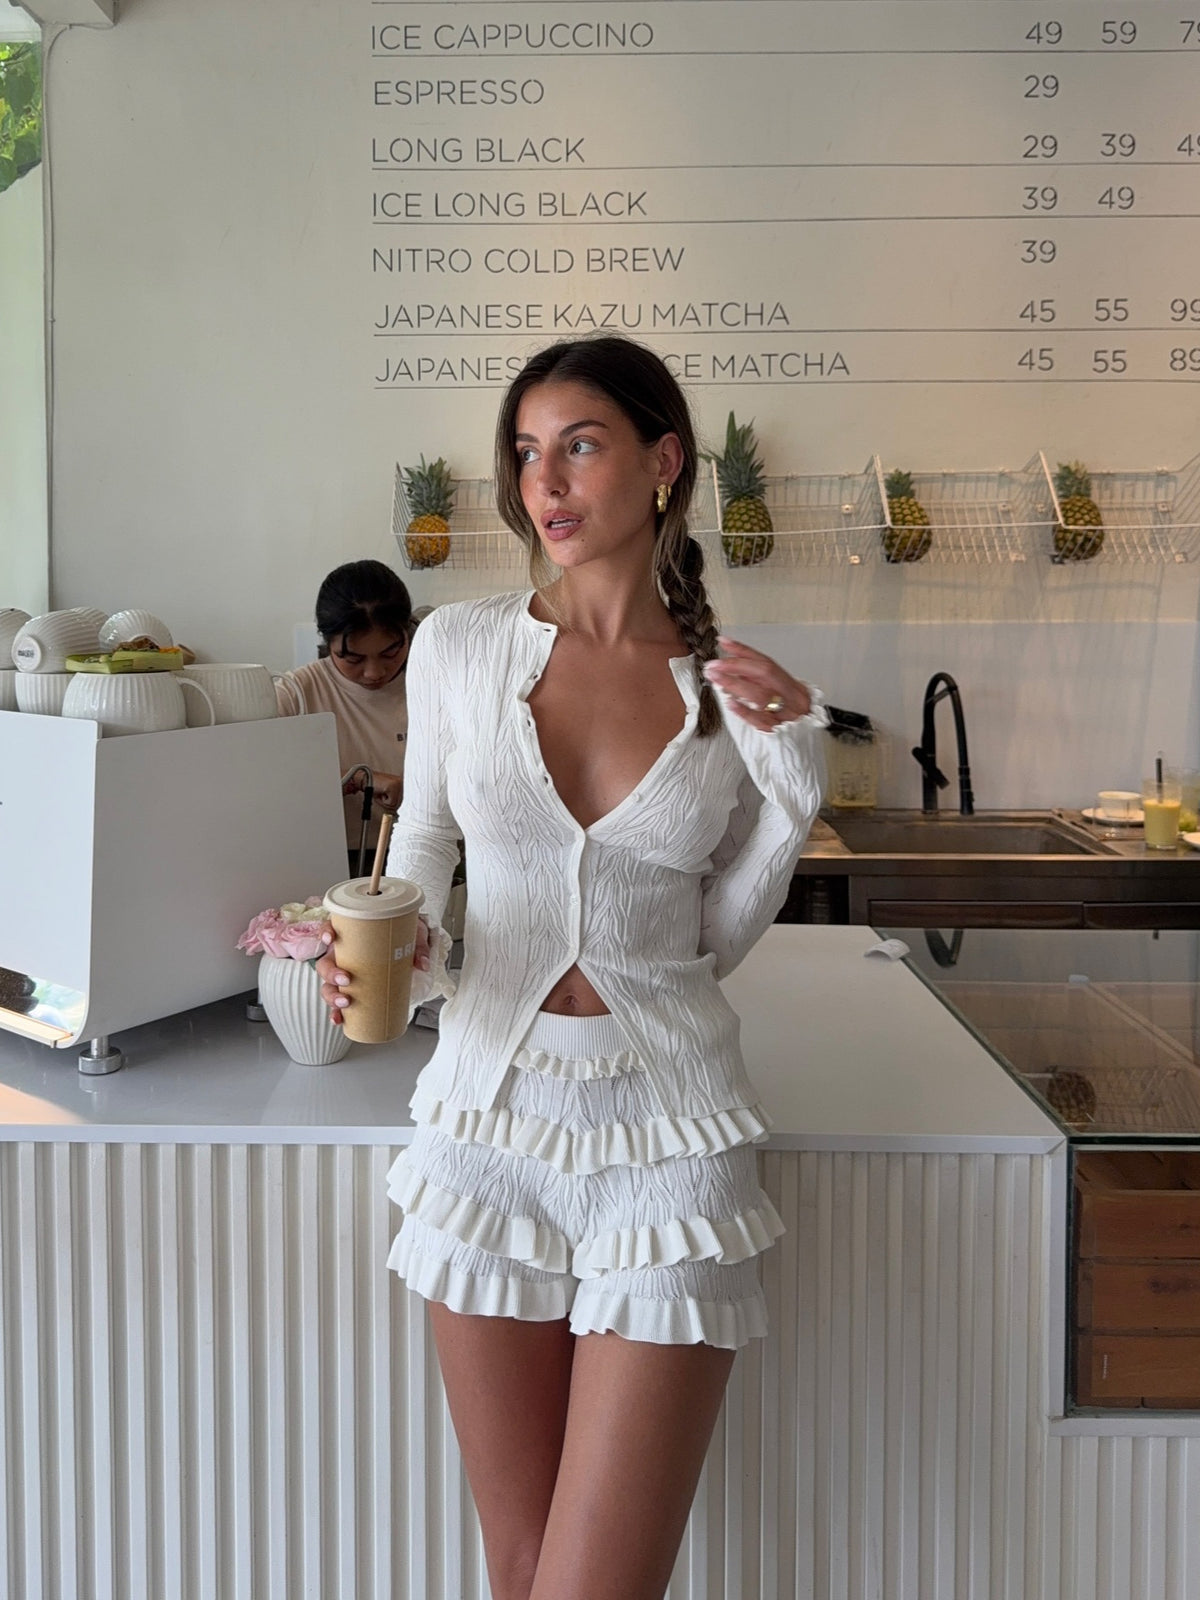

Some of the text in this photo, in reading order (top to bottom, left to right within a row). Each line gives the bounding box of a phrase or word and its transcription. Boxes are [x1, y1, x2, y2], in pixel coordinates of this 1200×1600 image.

[371, 22, 654, 50] ICE CAPPUCCINO
[1025, 20, 1200, 45] 49 59 7
[374, 79, 545, 106] ESPRESSO
[1023, 74, 1060, 99] 29
[372, 137, 586, 164] LONG BLACK
[1022, 133, 1200, 159] 29 39 4
[373, 191, 648, 218] ICE LONG BLACK
[1021, 186, 1135, 211] 39 49
[373, 247, 686, 274] NITRO COLD BREW
[1020, 240, 1057, 264] 39
[374, 302, 791, 329] JAPANESE KAZU MATCHA
[1019, 298, 1200, 323] 45 55 99
[375, 351, 851, 382] JAPANES CE MATCHA
[1017, 347, 1200, 374] 45 55 89
